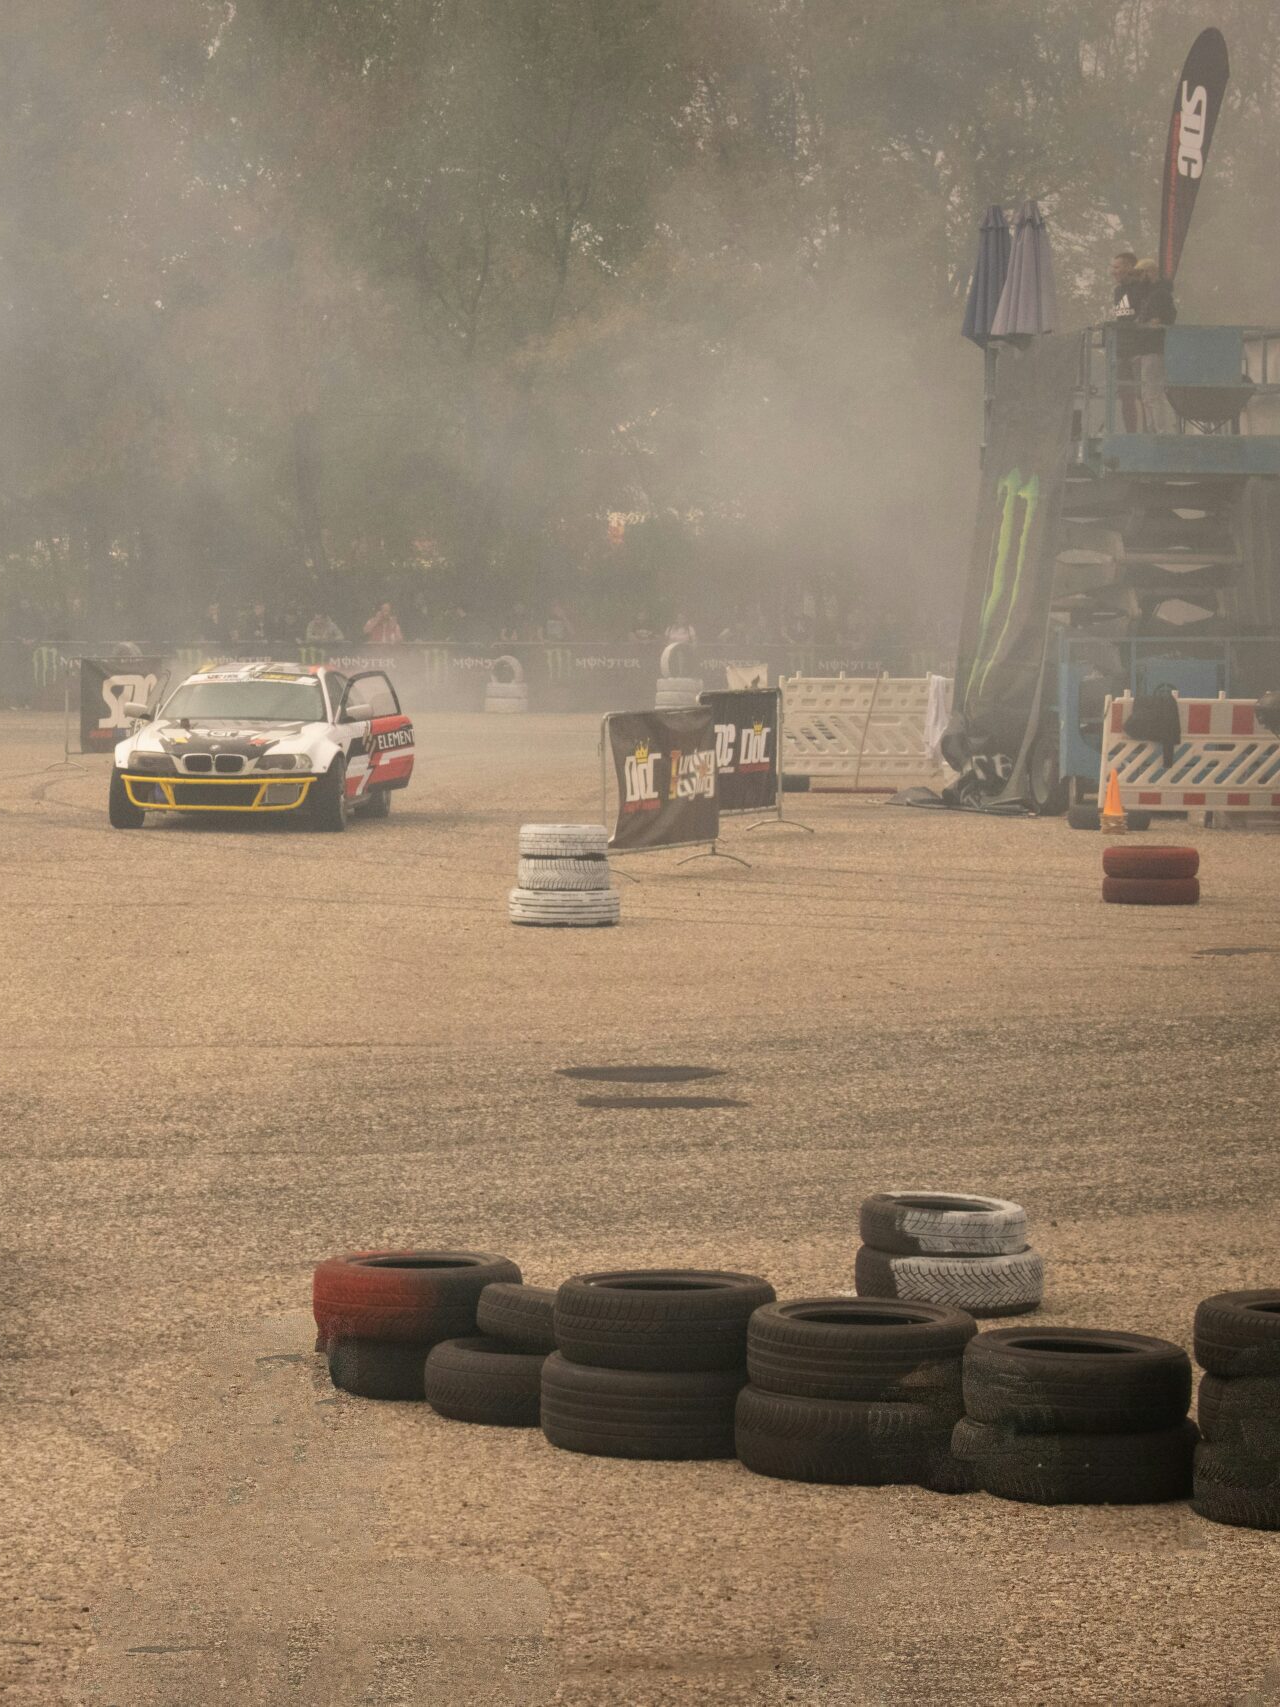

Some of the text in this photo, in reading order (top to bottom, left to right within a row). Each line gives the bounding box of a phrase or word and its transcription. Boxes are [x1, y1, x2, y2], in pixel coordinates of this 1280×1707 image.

[1177, 80, 1208, 179] SDC
[328, 655, 396, 670] MONSTER
[574, 657, 641, 671] MONSTER
